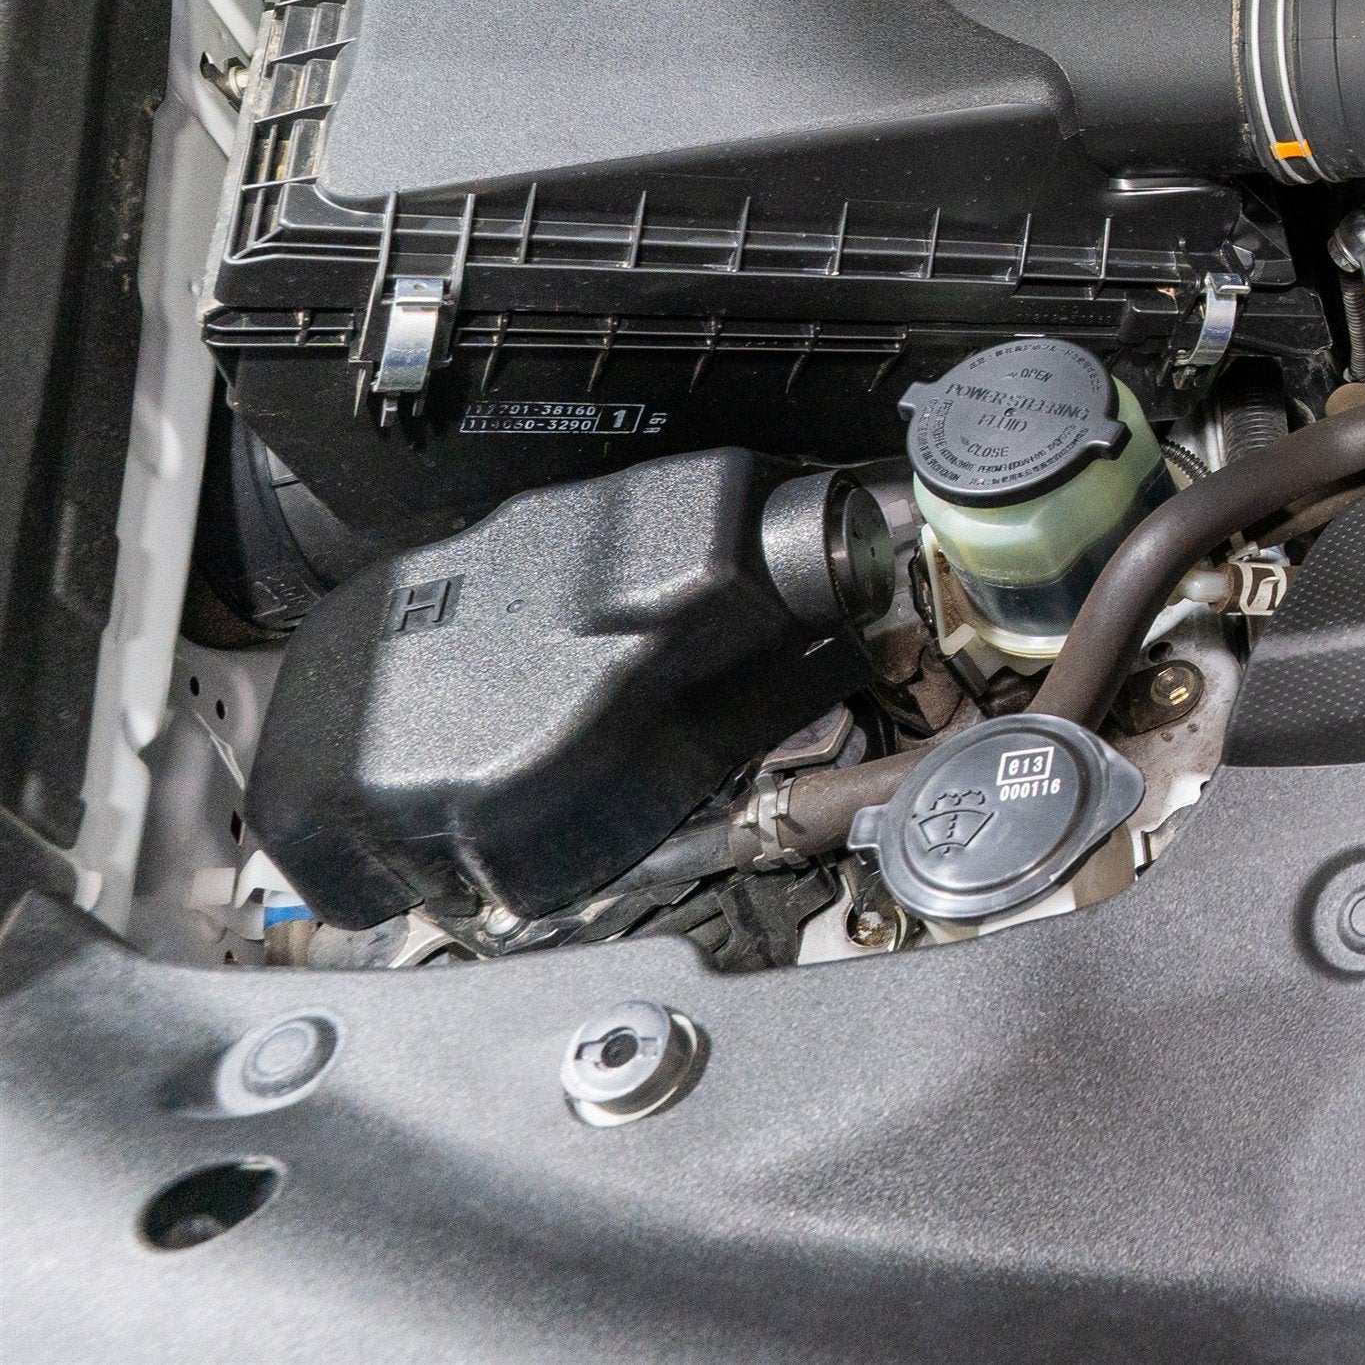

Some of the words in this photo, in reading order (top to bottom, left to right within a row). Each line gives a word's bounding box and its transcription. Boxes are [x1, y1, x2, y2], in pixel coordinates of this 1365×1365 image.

[1020, 367, 1053, 383] OPEN
[946, 383, 1008, 406] POWER
[1006, 394, 1090, 422] STEERING
[612, 409, 627, 428] 1
[977, 413, 1028, 434] FLUID
[966, 442, 1010, 458] CLOSE
[1008, 755, 1044, 776] e13
[999, 778, 1062, 802] 000116
